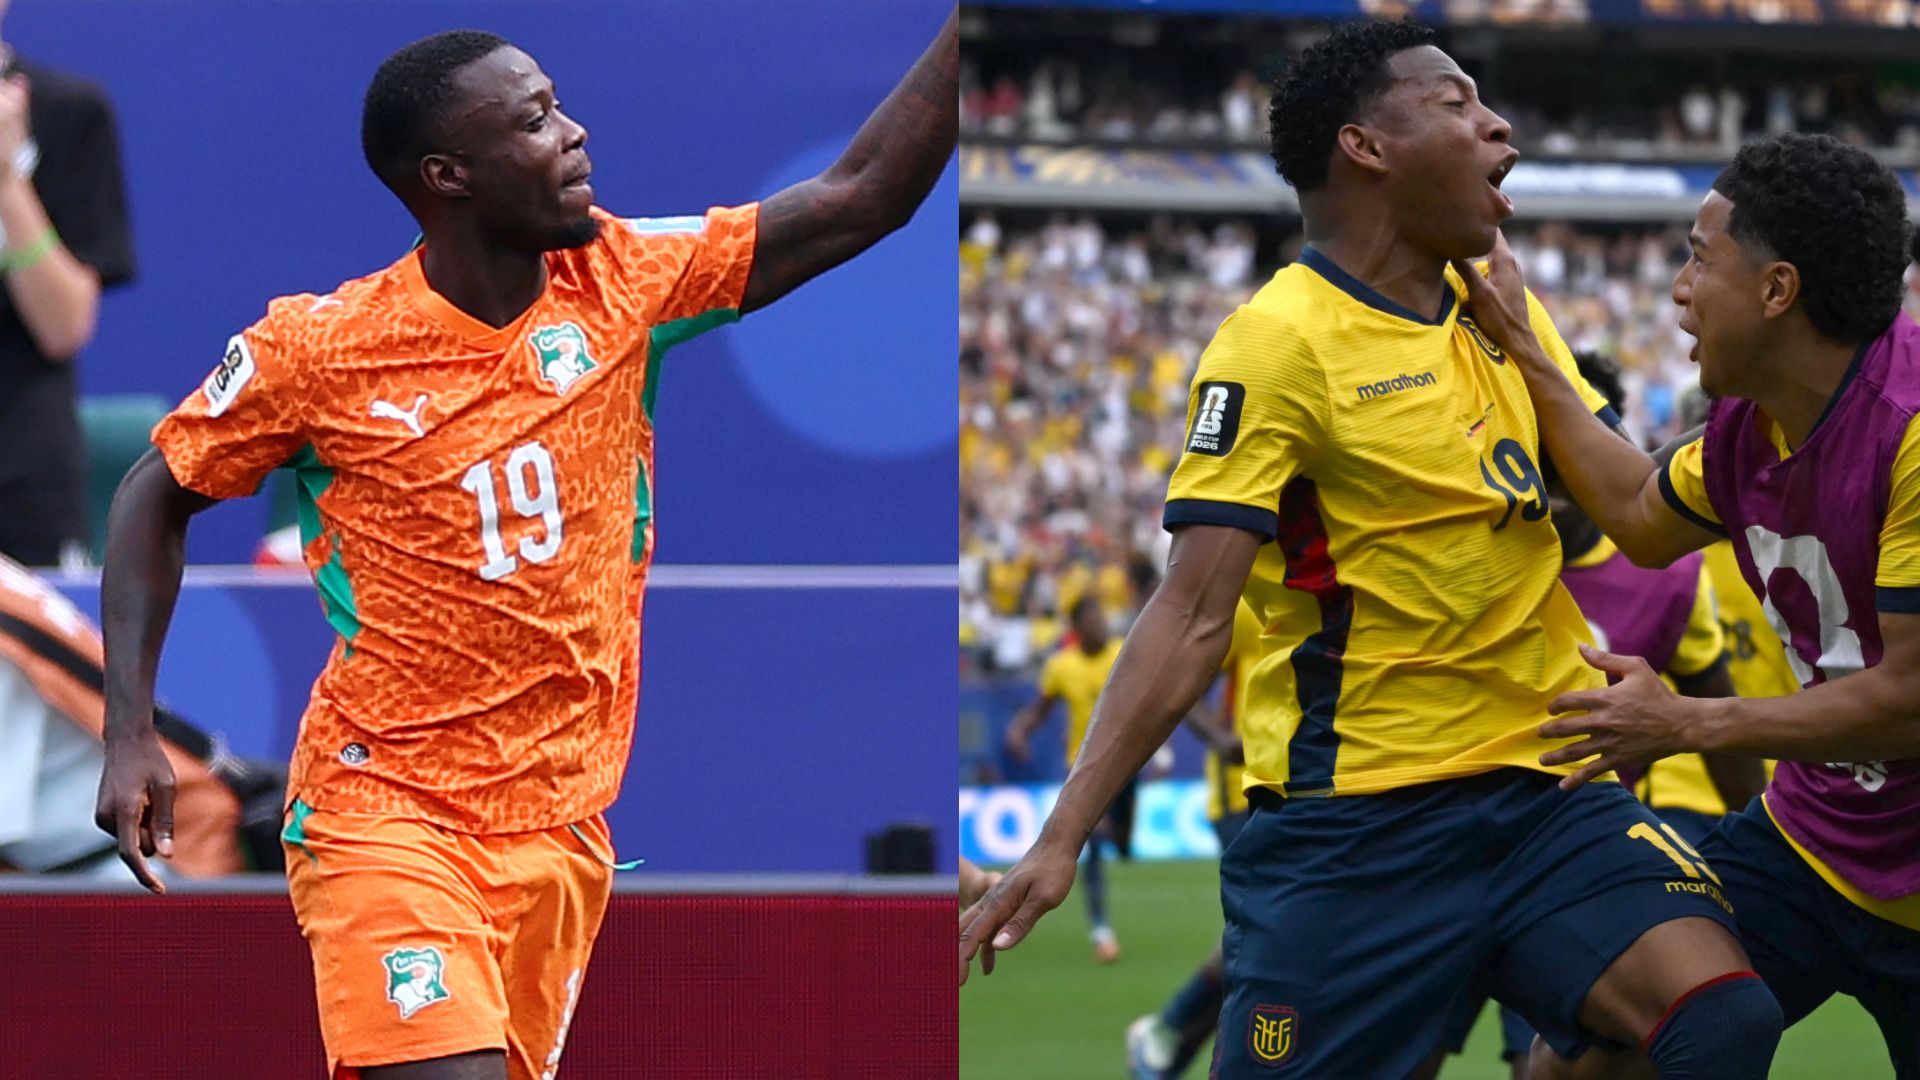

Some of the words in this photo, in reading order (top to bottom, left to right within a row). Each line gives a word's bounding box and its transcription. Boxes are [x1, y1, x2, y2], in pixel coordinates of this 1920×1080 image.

[1356, 371, 1437, 400] marathon
[1190, 440, 1218, 450] 2026
[460, 440, 562, 580] 19
[1479, 437, 1549, 532] 19
